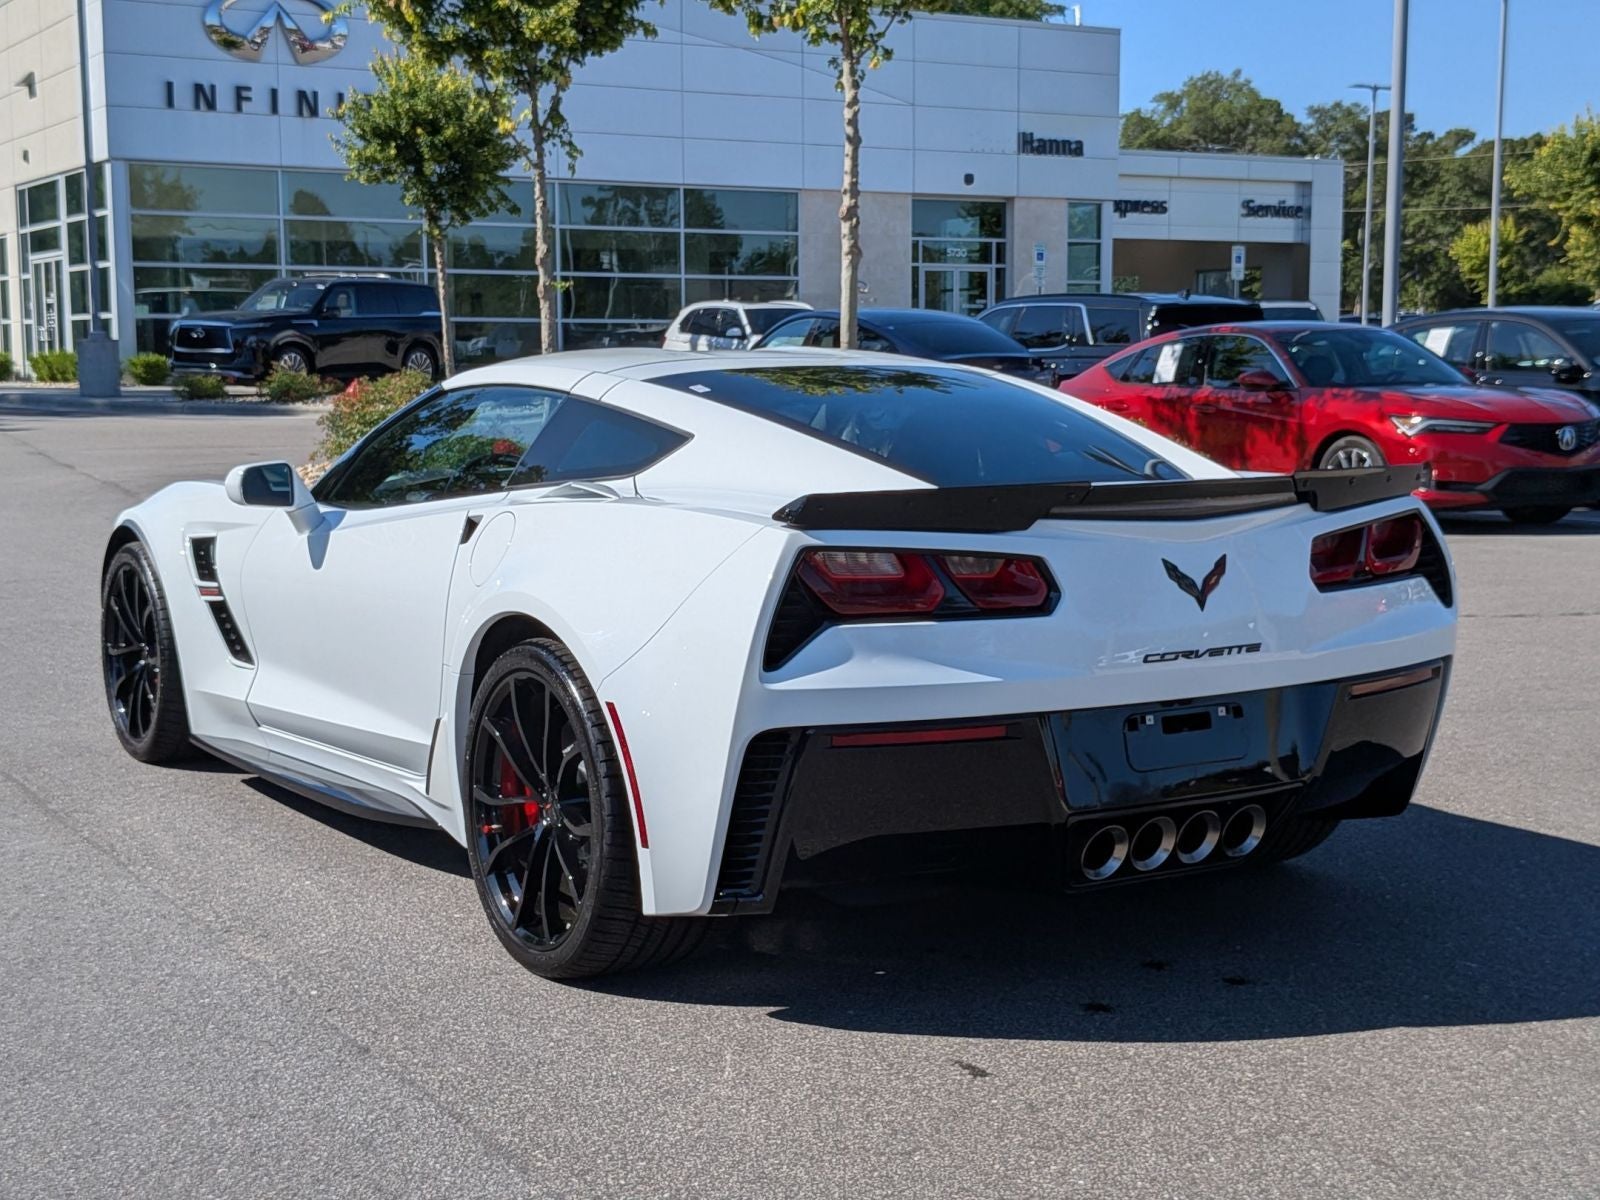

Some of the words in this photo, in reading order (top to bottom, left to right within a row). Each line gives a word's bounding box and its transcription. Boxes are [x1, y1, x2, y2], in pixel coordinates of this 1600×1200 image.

[165, 80, 374, 119] INFINI
[1017, 131, 1084, 157] Hanna
[1113, 199, 1168, 218] xpress
[1240, 199, 1304, 219] Service
[1142, 642, 1262, 664] CORVETTE
